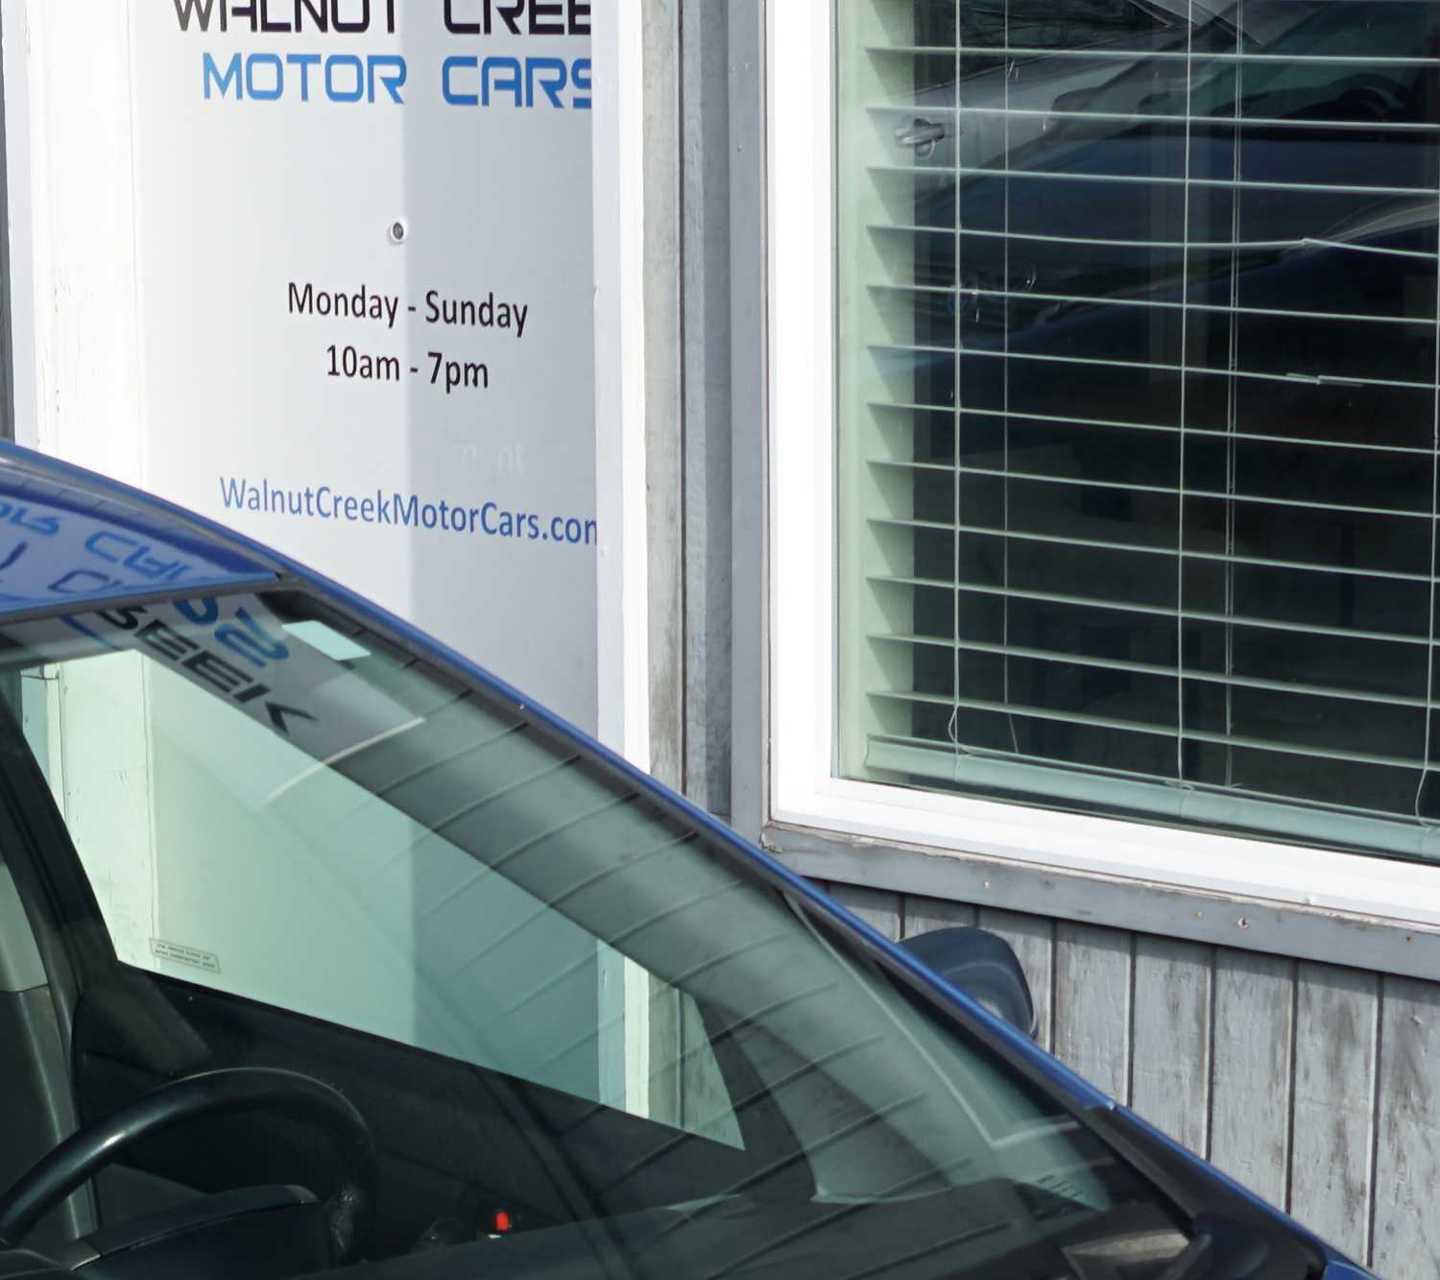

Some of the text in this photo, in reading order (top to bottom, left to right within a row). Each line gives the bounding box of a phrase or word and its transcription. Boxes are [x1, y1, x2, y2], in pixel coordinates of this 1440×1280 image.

[172, 0, 592, 35] WALNUT CREE
[202, 52, 407, 104] MOTOR
[288, 281, 399, 328] Monday
[424, 289, 529, 338] Sunday
[325, 344, 401, 382] 10am
[427, 351, 490, 394] 7pm
